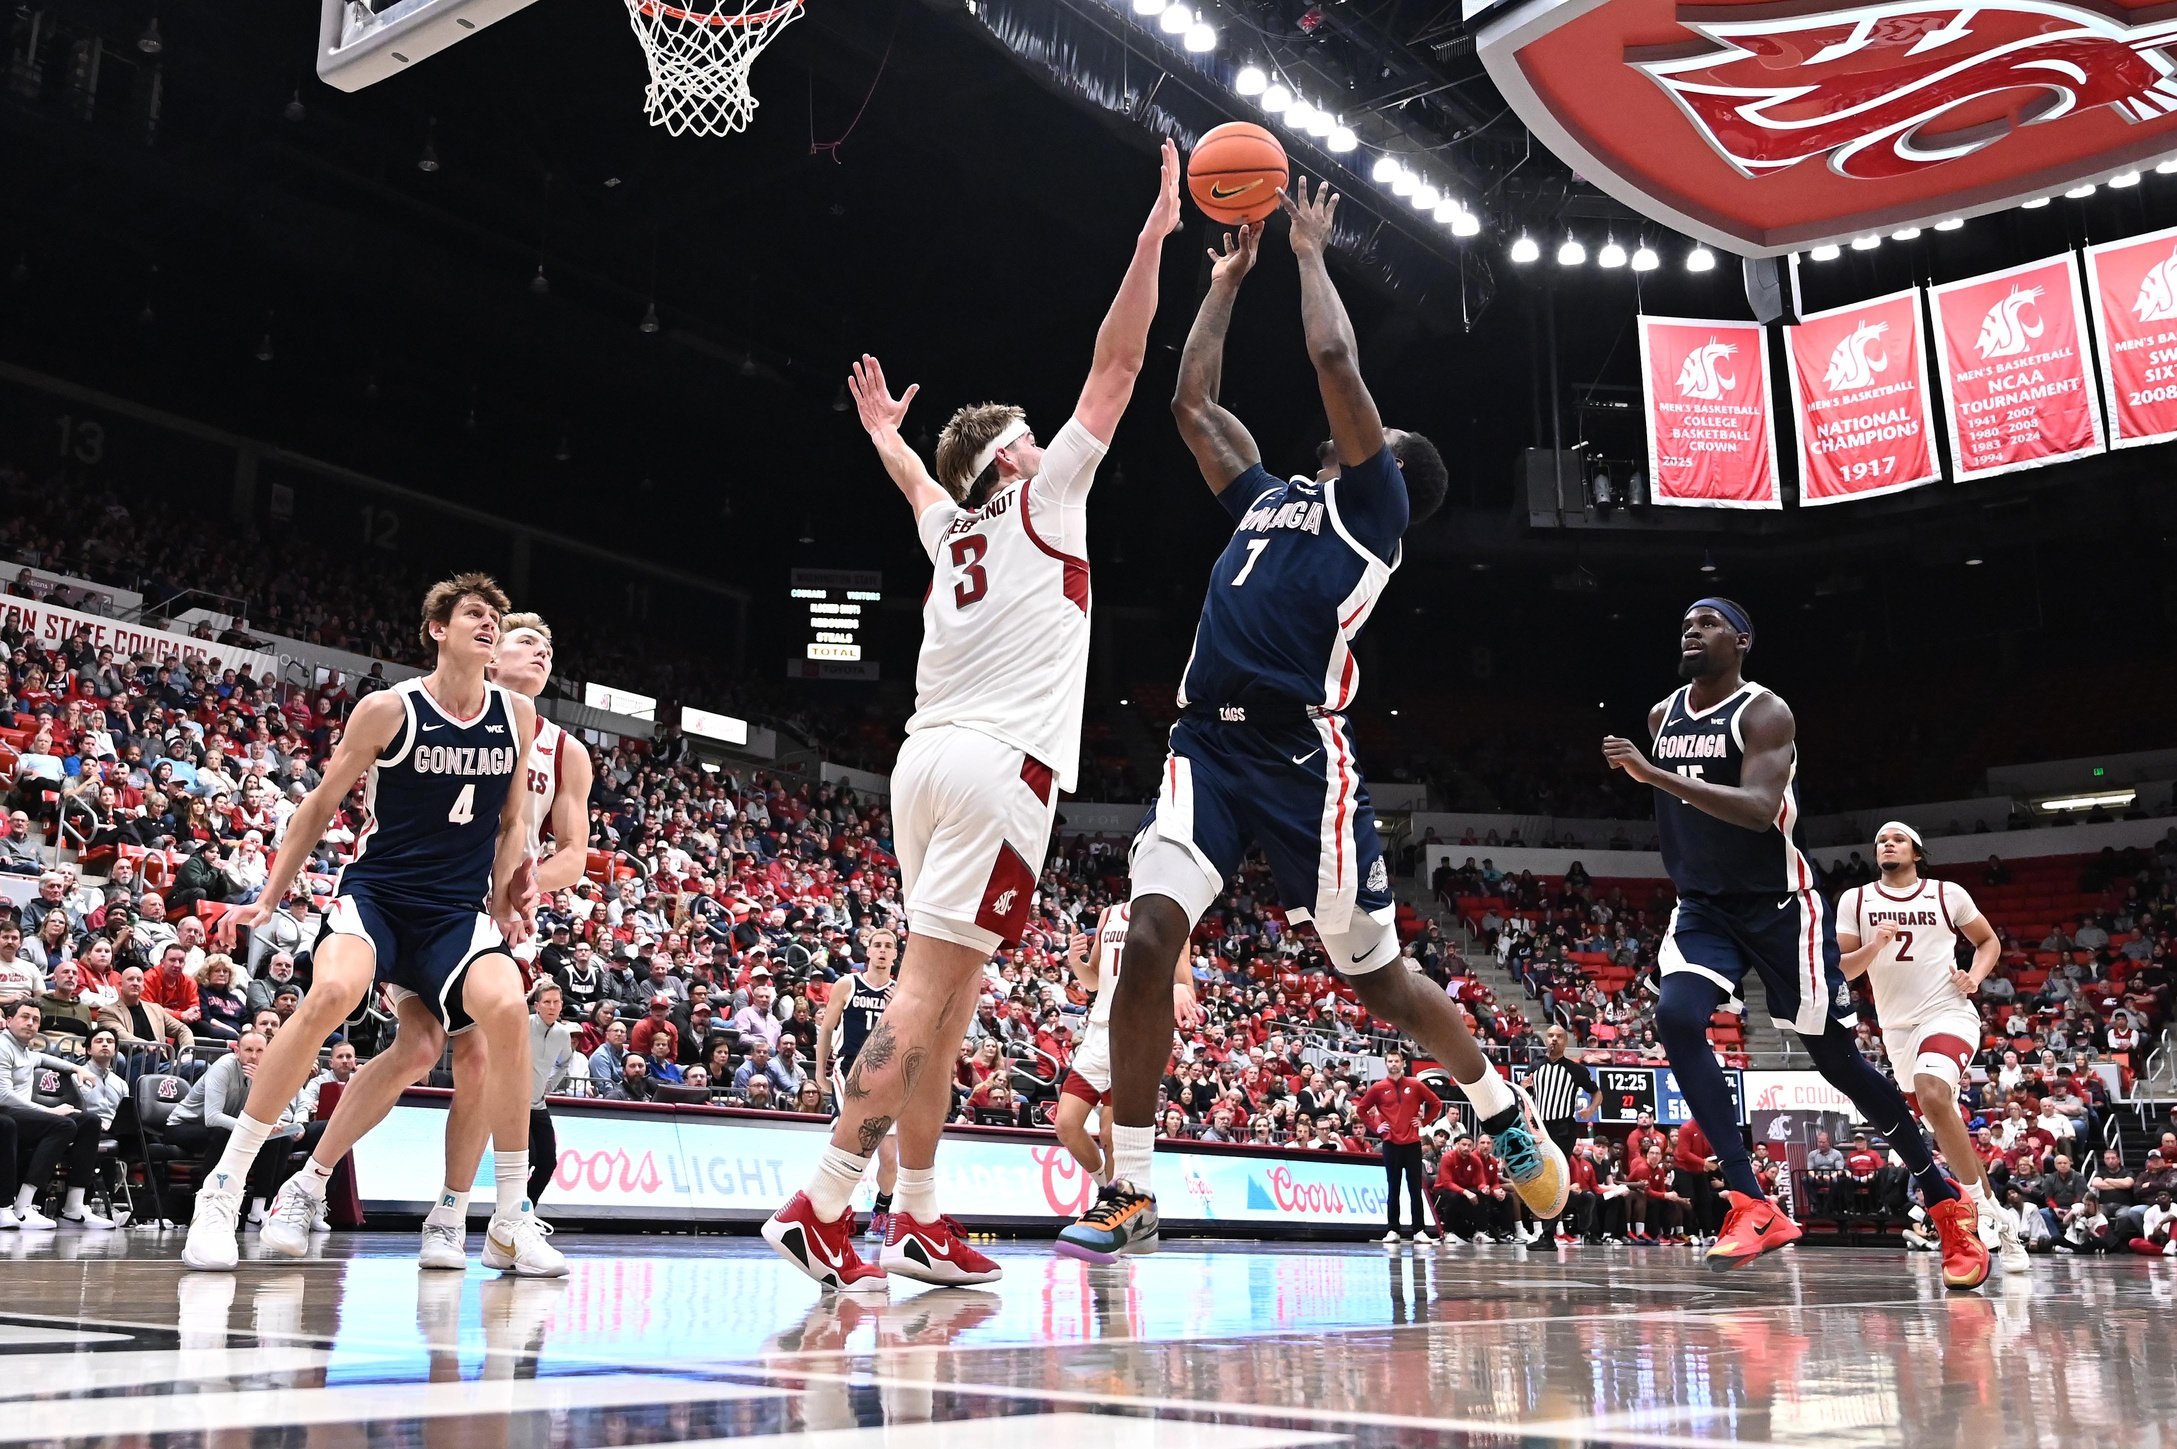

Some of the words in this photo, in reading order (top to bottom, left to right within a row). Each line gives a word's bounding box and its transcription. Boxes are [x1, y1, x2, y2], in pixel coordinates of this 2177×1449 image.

[2114, 336, 2154, 352] MEN'S
[2158, 331, 2177, 344] BA
[1956, 366, 1993, 382] MEN'S
[1996, 347, 2073, 373] BASKETBALL
[2149, 347, 2177, 365] SW
[1988, 369, 2044, 393] NCAA
[1807, 397, 1840, 412] MEN'S
[1842, 380, 1915, 405] BASKETBALL
[1960, 377, 2079, 415] TOURNAMENT
[2129, 384, 2177, 406] 2008
[1660, 402, 1691, 413] MEN'S
[1694, 403, 1760, 415] BASKETBALL
[1968, 414, 1996, 428] 1941
[2006, 406, 2037, 420] 2007
[1683, 416, 1738, 428] COLLEGE
[1816, 407, 1911, 438] NATIONAL
[1969, 427, 1999, 440] 1980
[2008, 418, 2039, 433] 2008
[1672, 429, 1751, 441] BASKETBALL
[1810, 420, 1919, 455] CHAMPIONS
[1971, 440, 2001, 453] 1983
[2010, 431, 2041, 445] 2024
[1689, 441, 1737, 452] CROWN
[1662, 456, 1693, 467] 2025
[1840, 455, 1896, 482] 1917
[1973, 452, 2003, 467] 1994
[949, 533, 989, 610] 3
[1231, 539, 1270, 586] 7
[812, 647, 857, 657] TOTAL
[1219, 706, 1246, 722] ZAGS
[1658, 733, 1727, 760] GONZAGA
[414, 744, 514, 776] GONZAGA
[448, 783, 476, 826] 4
[1868, 911, 1937, 927] COUGARS
[1895, 931, 1914, 962] 2
[852, 996, 886, 1010] GONZA
[1607, 1073, 1647, 1091] 12:25
[1622, 1095, 1634, 1107] 27
[1794, 1086, 1852, 1106] COUGA
[553, 1147, 663, 1194] oors
[667, 1154, 785, 1197] LIGHT
[1266, 1165, 1344, 1214] Coors
[1341, 1186, 1389, 1214] LIGH
